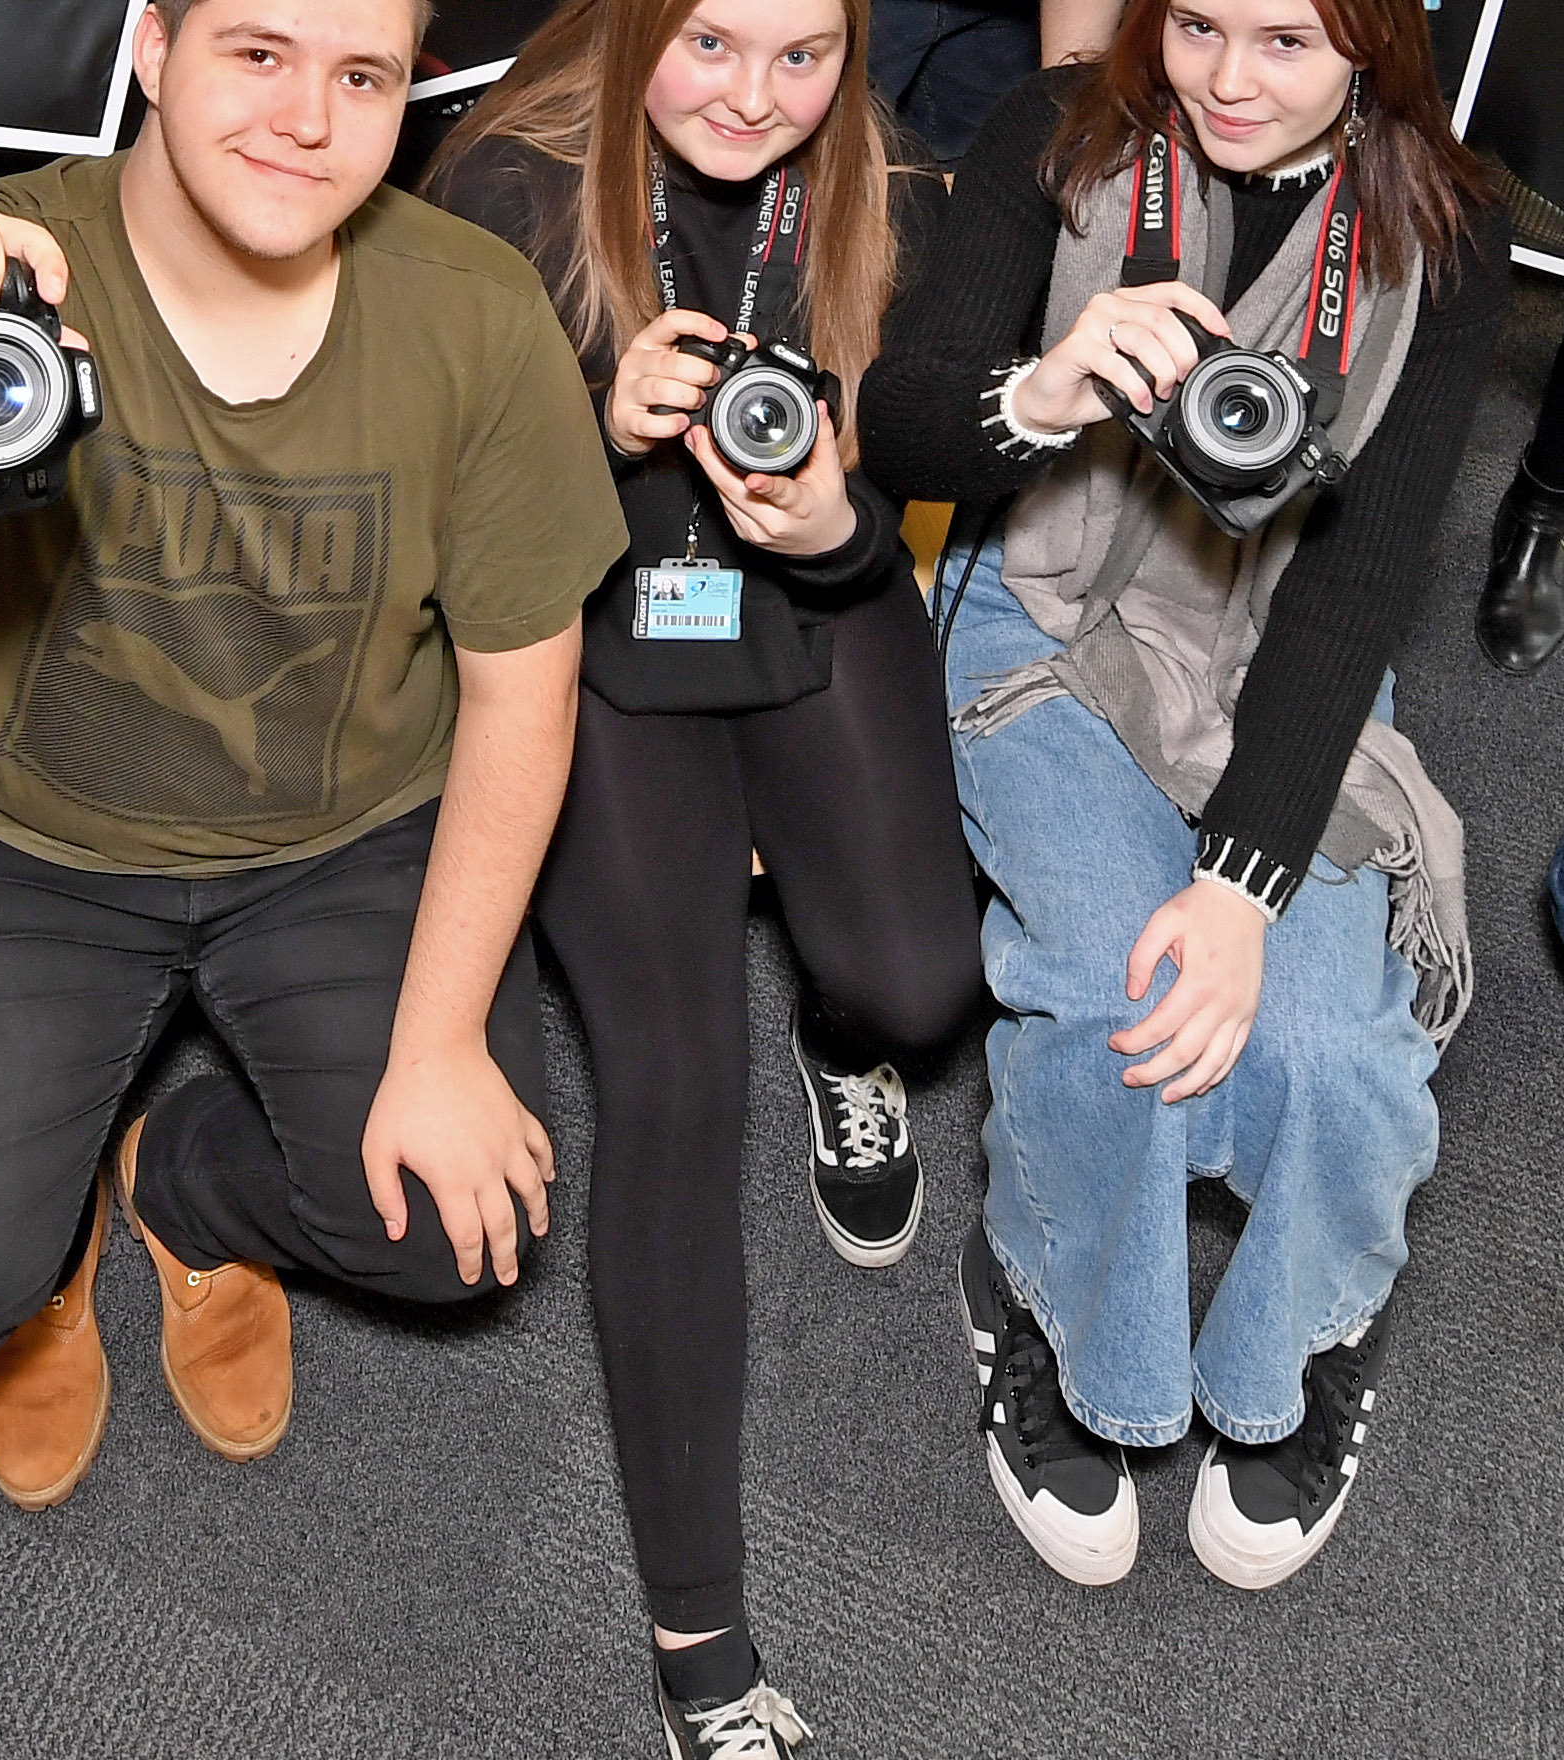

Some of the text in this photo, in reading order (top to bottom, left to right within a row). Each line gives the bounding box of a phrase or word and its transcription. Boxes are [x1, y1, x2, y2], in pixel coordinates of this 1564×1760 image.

[756, 170, 779, 233] EARNER
[1144, 132, 1168, 230] Canon
[779, 186, 800, 234] EOS
[659, 260, 677, 311] LEARN
[1318, 211, 1349, 337] EOS 90D
[736, 271, 760, 335] LEARNE
[774, 345, 809, 369] Canon
[78, 361, 96, 413] Canon
[638, 593, 648, 635] STUDENT
